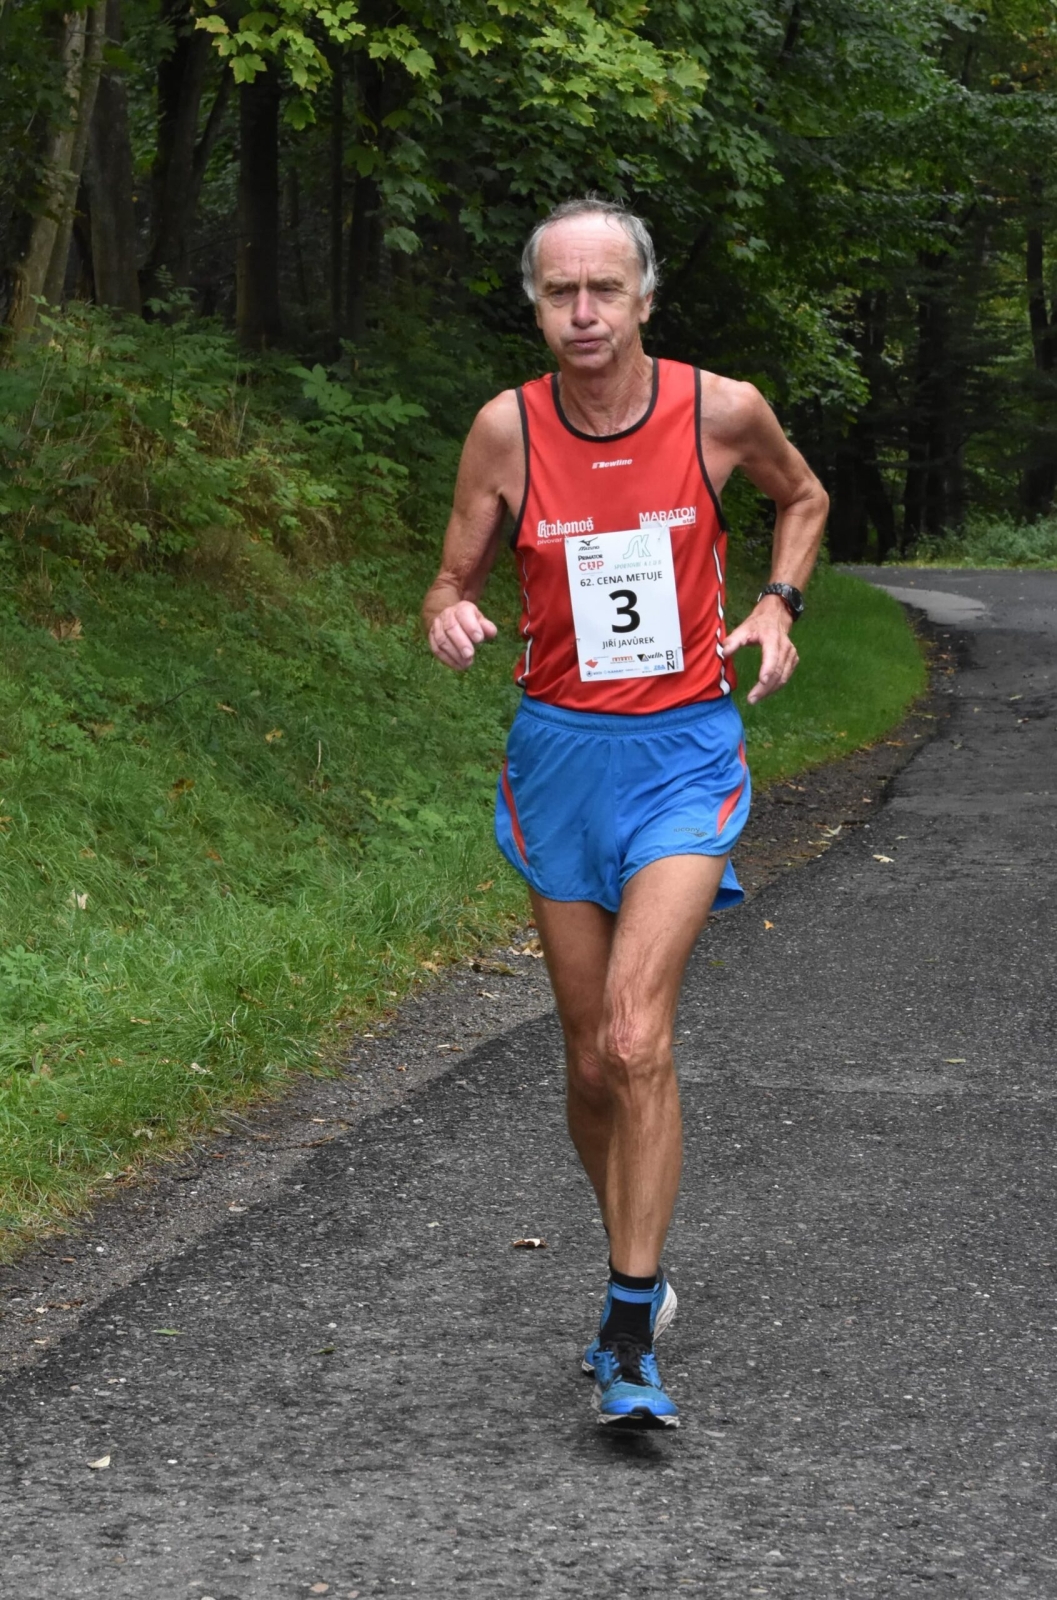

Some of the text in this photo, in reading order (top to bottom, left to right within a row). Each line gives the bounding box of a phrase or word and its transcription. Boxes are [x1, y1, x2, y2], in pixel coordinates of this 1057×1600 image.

[639, 506, 697, 523] MARATON
[537, 516, 594, 538] Krakonoš
[578, 560, 604, 572] CUP
[580, 570, 663, 587] 62. CENA METUJE
[609, 589, 641, 633] 3
[602, 636, 655, 649] JIŘÍ JAVŮREK
